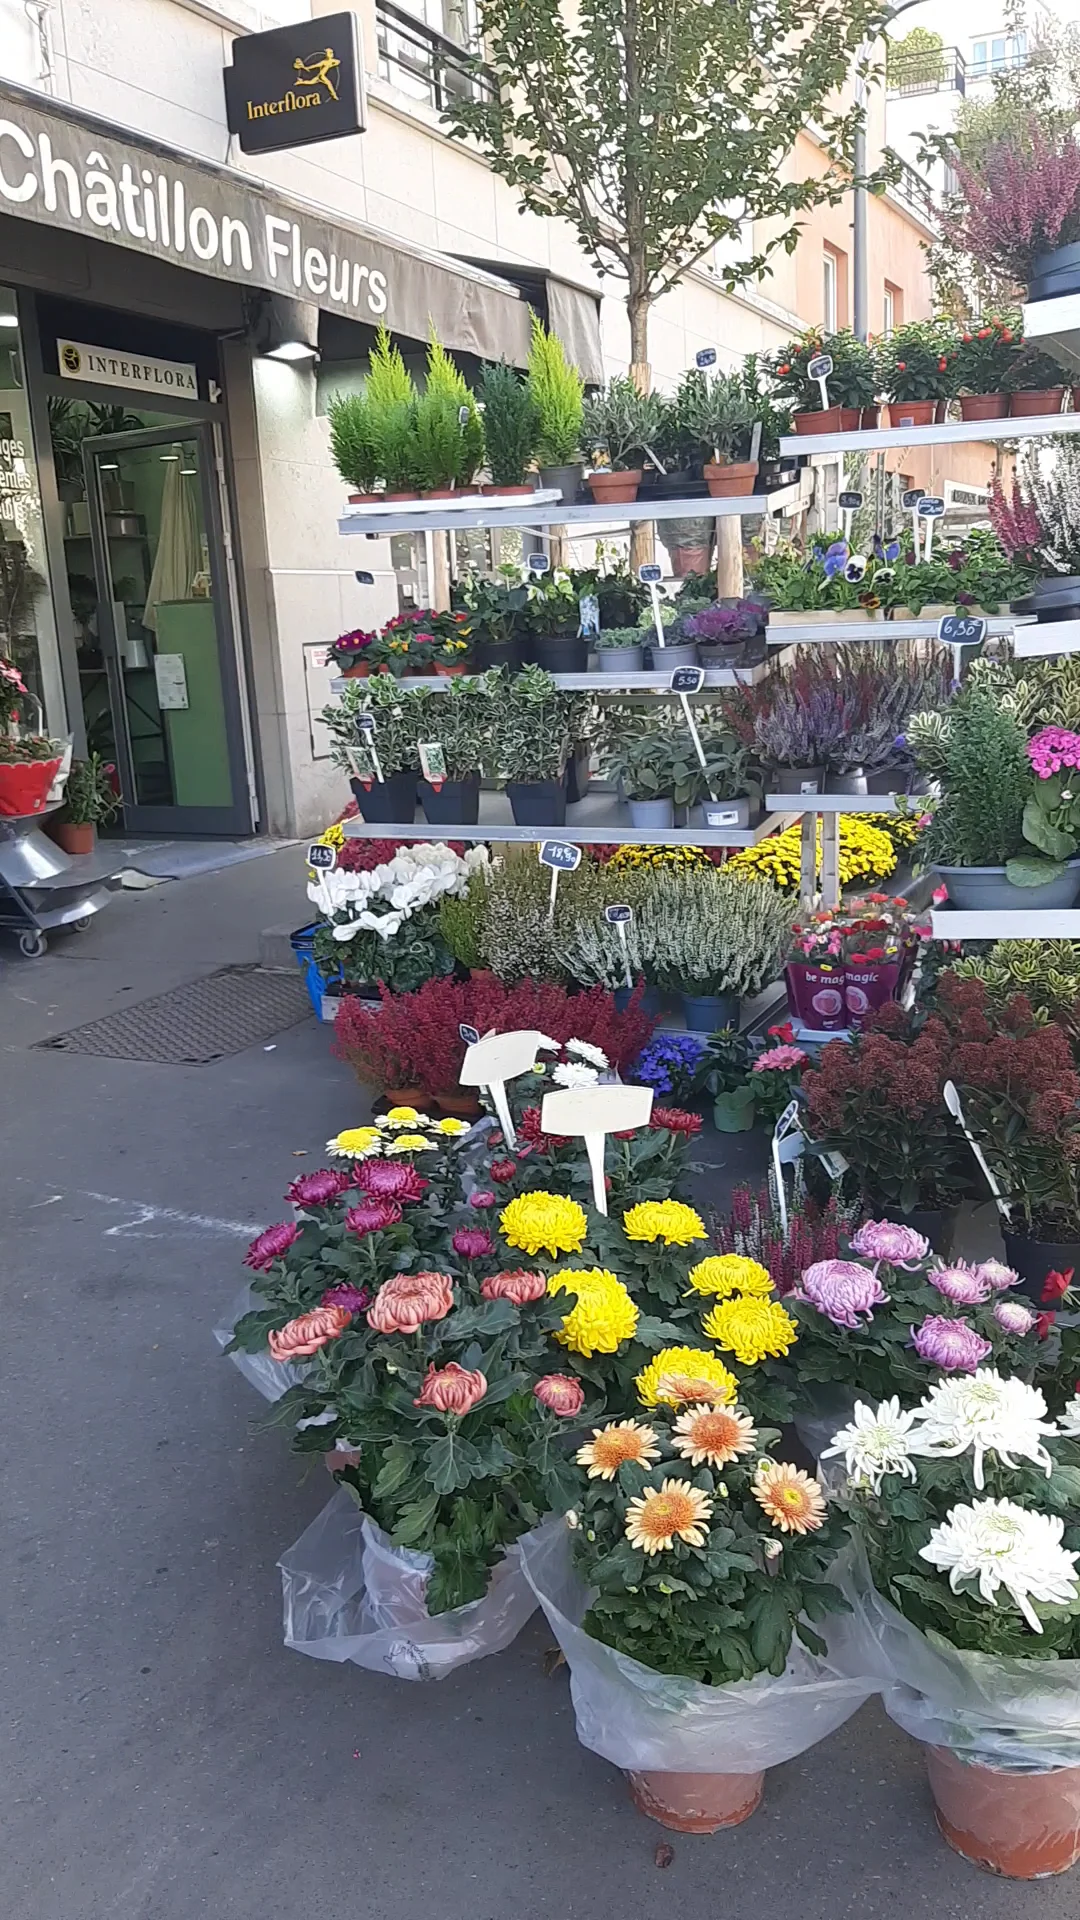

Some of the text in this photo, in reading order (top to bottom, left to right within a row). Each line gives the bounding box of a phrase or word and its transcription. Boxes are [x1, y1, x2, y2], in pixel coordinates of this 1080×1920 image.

[246, 91, 322, 120] Interflora
[0, 118, 389, 314] Châtillon Fleurs
[87, 355, 196, 390] INTERFLORA
[0, 438, 25, 468] ges
[805, 971, 844, 985] be mag
[845, 972, 880, 984] magic
